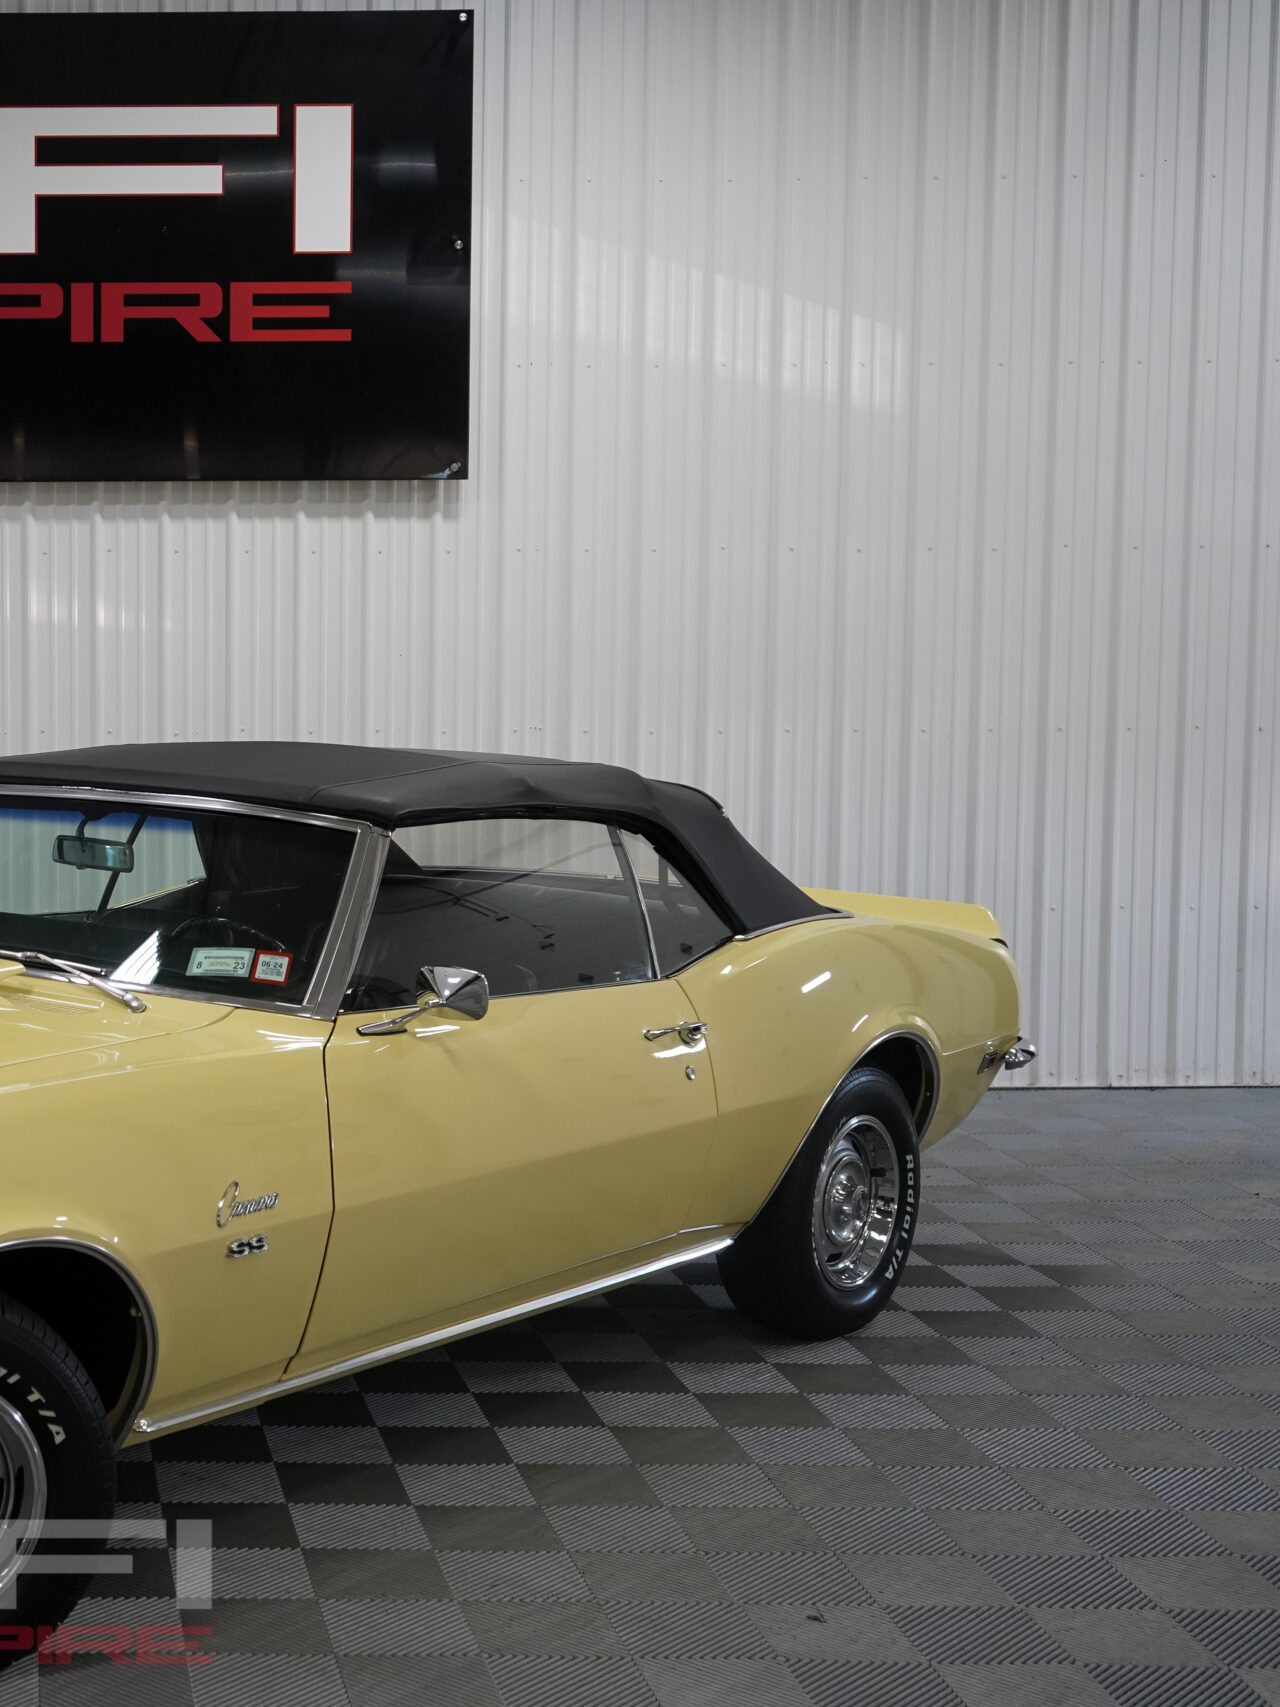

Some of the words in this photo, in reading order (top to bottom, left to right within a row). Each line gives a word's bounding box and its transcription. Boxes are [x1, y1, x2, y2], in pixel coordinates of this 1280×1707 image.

[233, 961, 246, 970] 23
[261, 960, 271, 968] 06
[273, 961, 283, 969] 24
[901, 1154, 915, 1239] Radial
[226, 1234, 268, 1258] SS
[884, 1248, 904, 1280] T/A
[25, 1388, 67, 1447] T/A
